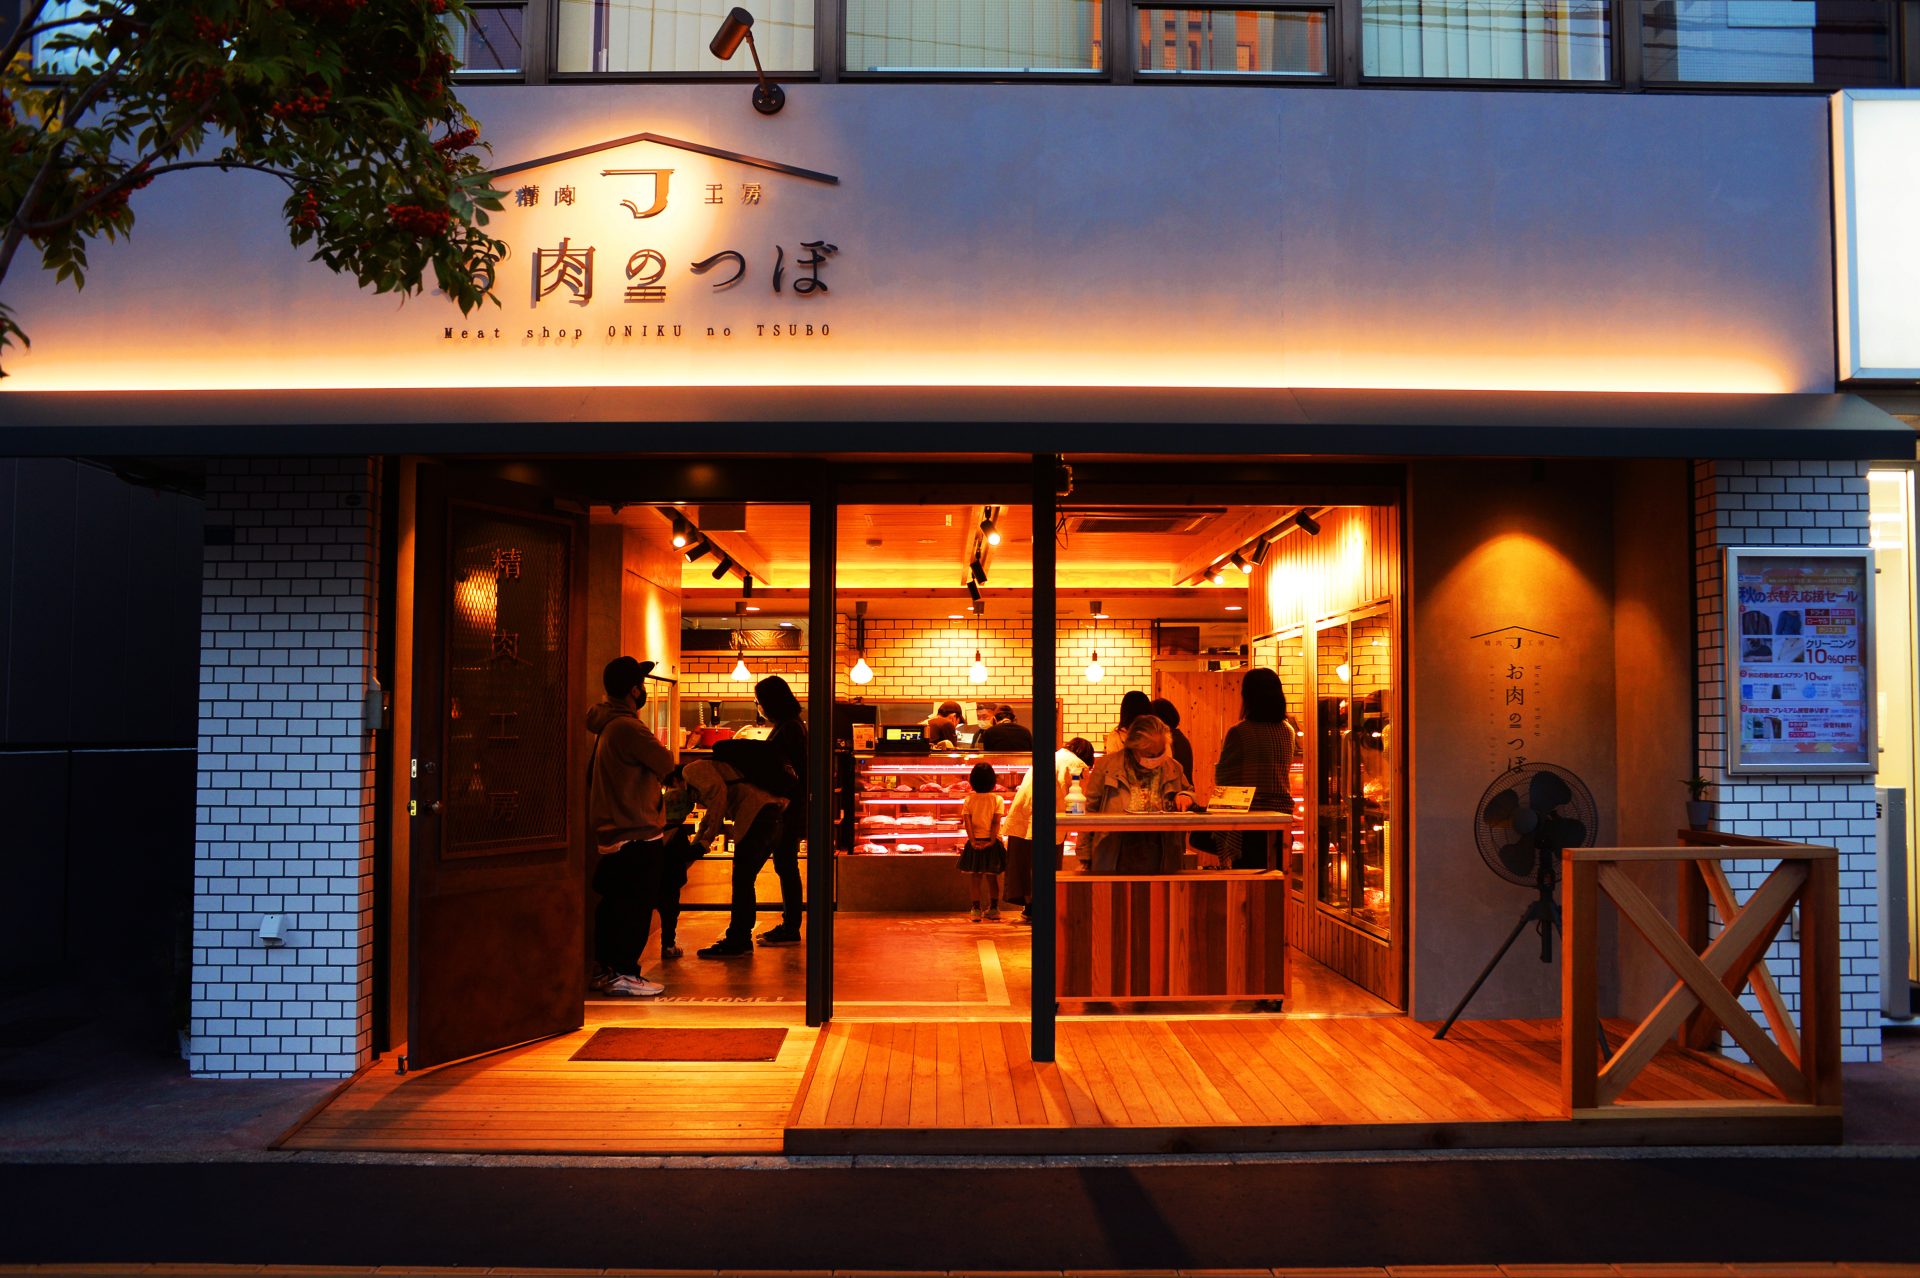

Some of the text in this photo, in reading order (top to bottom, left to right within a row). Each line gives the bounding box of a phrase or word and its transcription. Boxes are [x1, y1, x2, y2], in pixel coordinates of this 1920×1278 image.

[517, 184, 576, 207] 精肉
[704, 182, 762, 205] 工房
[444, 324, 831, 340] Meat shop ONIKU no TSUBO
[1805, 639, 1857, 649] クリーニング
[1805, 649, 1857, 665] 10%OFF
[1505, 663, 1527, 774] お肉のつぼ
